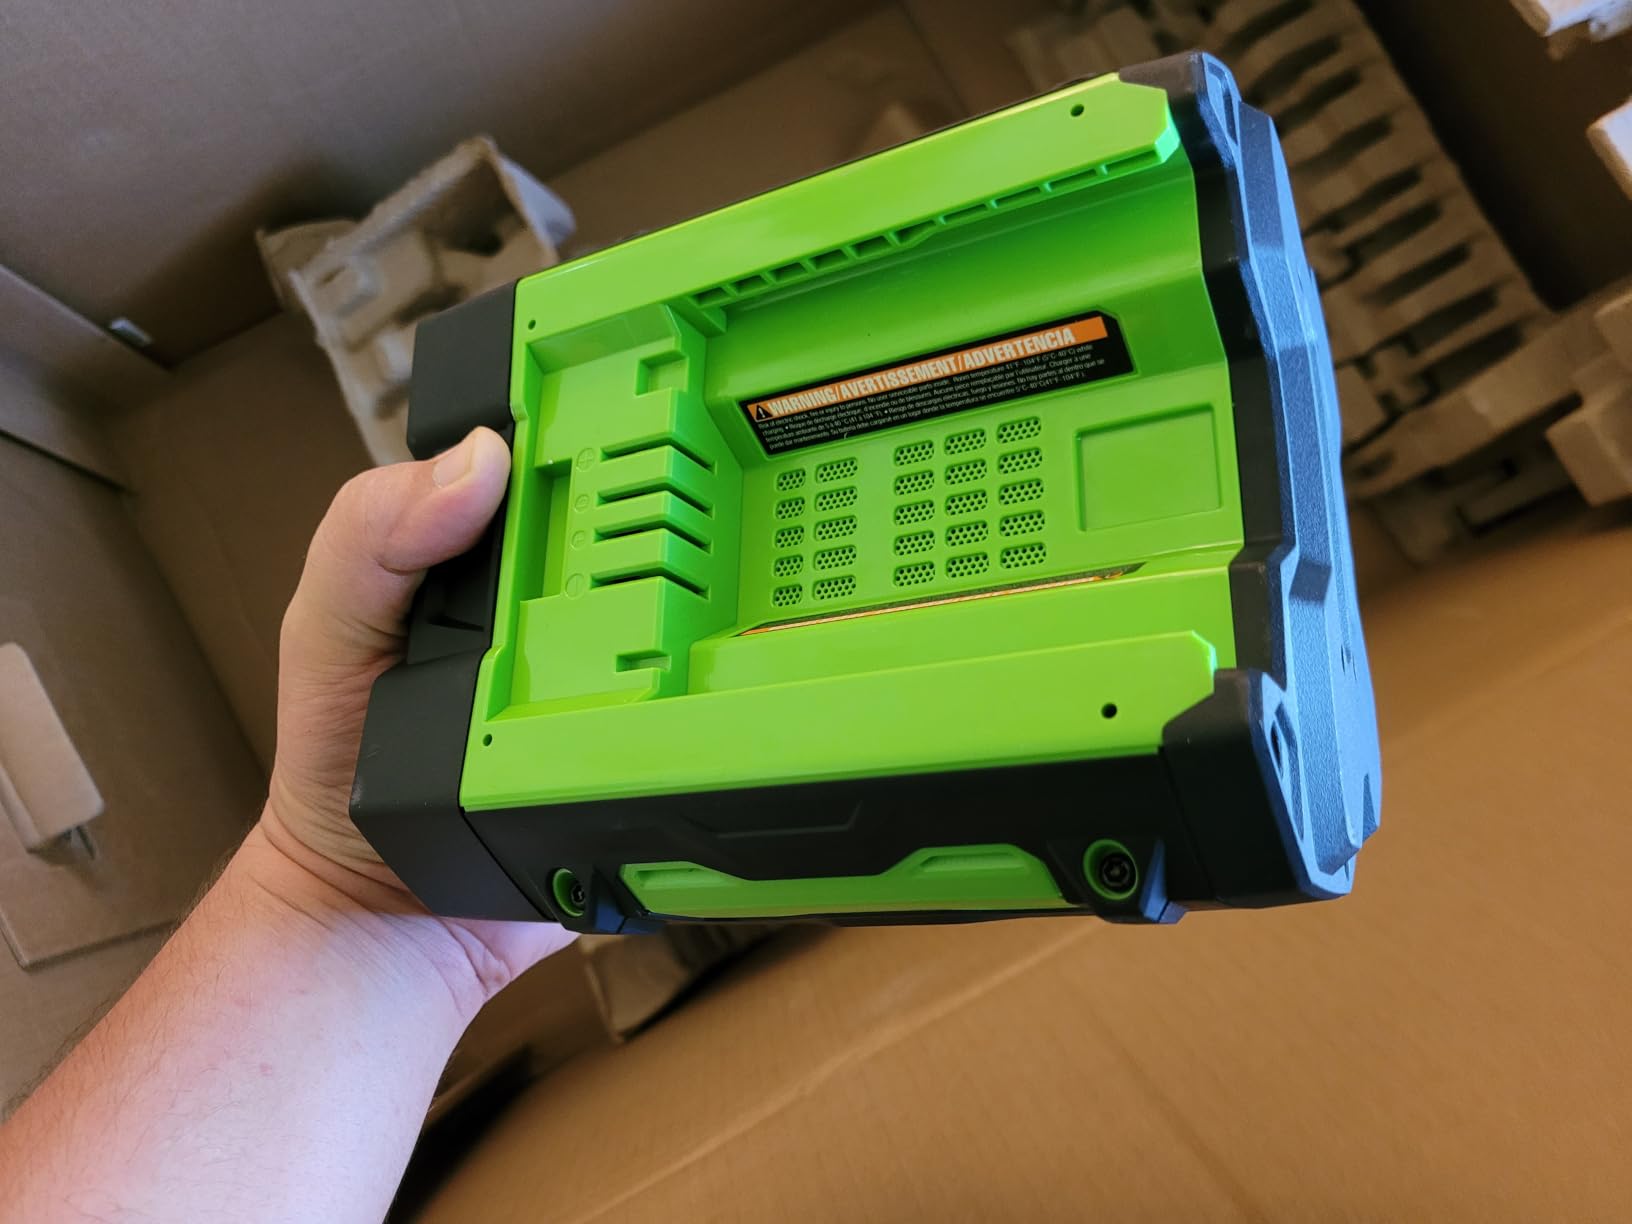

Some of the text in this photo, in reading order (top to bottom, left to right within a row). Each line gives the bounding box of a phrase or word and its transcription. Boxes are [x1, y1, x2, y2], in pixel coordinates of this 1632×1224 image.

[757, 421, 769, 429] Risk
[823, 404, 840, 414] injury
[866, 395, 877, 403] No
[875, 393, 888, 401] user
[917, 382, 934, 392] parts
[951, 373, 970, 383] Room
[968, 364, 1006, 380] temperature
[1074, 343, 1094, 353] while
[766, 327, 1076, 416] WARNING/AVERTISSEMENT/ADVERTENCIA
[861, 411, 874, 419] 104
[887, 404, 908, 415] Riesgo
[913, 395, 943, 409] descargas
[969, 385, 988, 396] fuego
[1015, 376, 1027, 384] No
[1024, 373, 1039, 383] hay
[1036, 369, 1058, 380] partes
[1062, 362, 1084, 373] dentro
[1082, 360, 1098, 369] que
[896, 396, 906, 404] de
[931, 385, 954, 395] Aucune
[1003, 371, 1016, 380] par
[1047, 356, 1074, 369] Charger
[1077, 353, 1092, 361] une
[767, 440, 785, 450] puede
[829, 427, 839, 435] Su
[854, 420, 870, 429] debe
[906, 408, 923, 418] lugar
[920, 404, 939, 414] donde
[943, 395, 979, 409] temperatura
